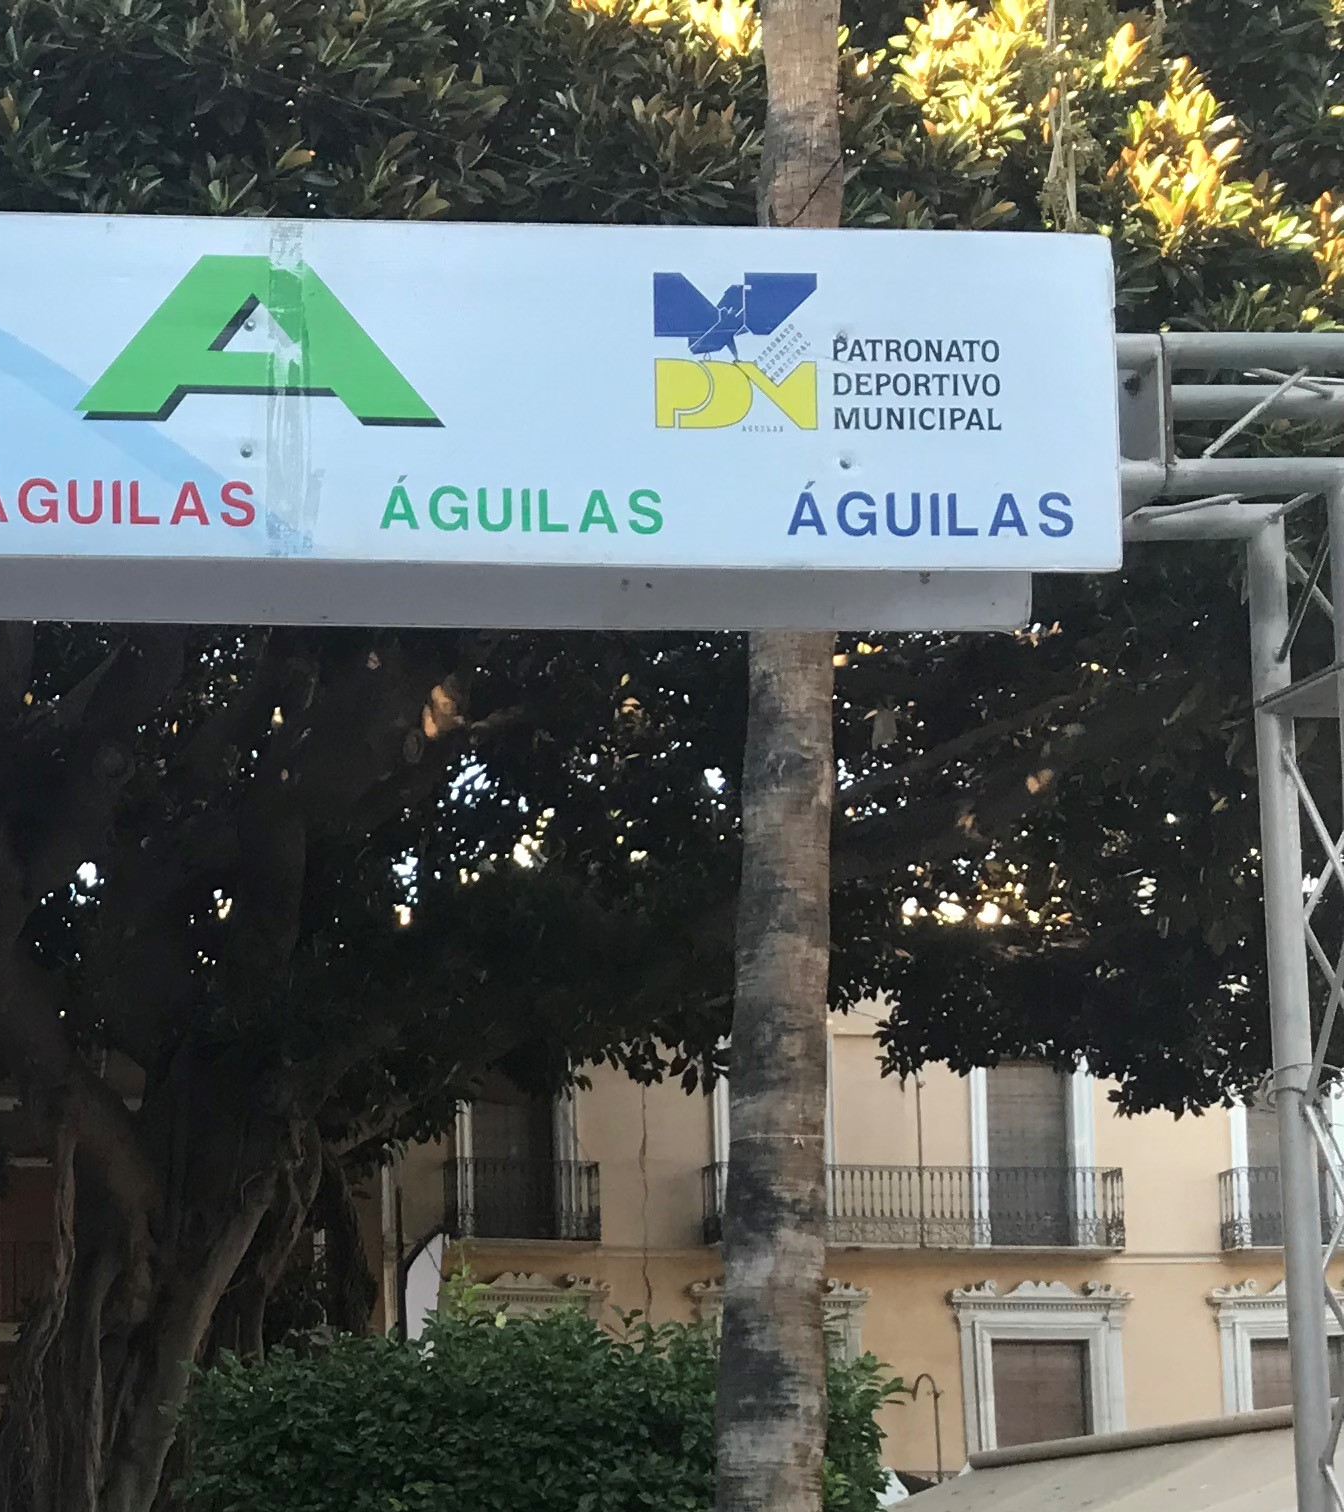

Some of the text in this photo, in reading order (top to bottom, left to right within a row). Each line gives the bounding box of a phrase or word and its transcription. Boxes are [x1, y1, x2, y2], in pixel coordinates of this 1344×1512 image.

[833, 337, 1001, 363] PATRONATO
[833, 372, 1002, 397] DEPORTIVO
[834, 406, 1002, 431] MUNICIPAL
[379, 475, 664, 536] ÁGUILAS
[788, 481, 1075, 539] ÁGUILAS
